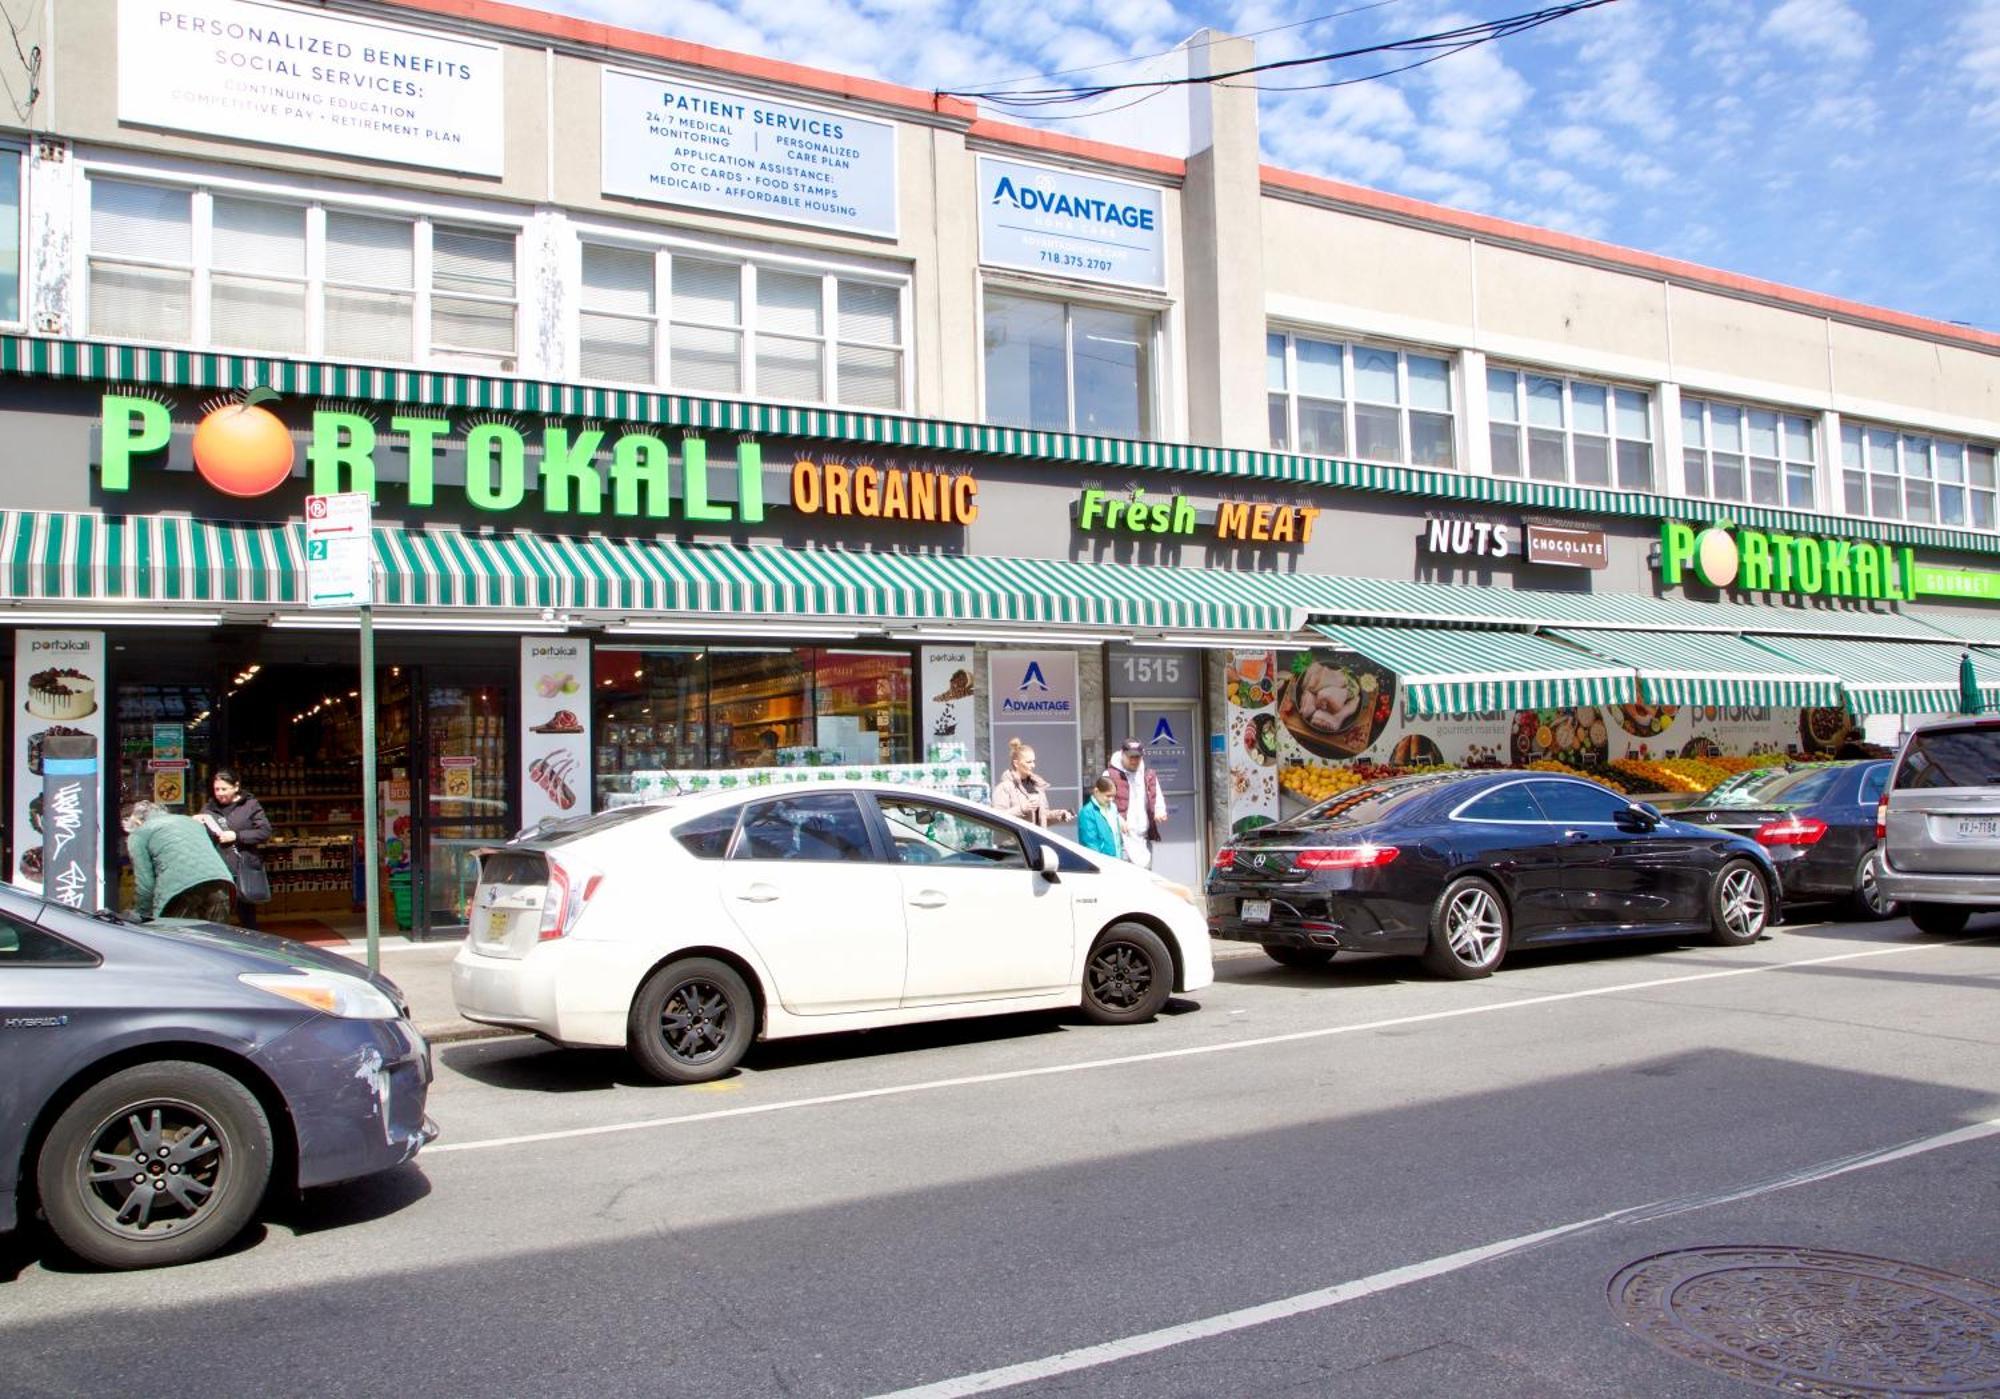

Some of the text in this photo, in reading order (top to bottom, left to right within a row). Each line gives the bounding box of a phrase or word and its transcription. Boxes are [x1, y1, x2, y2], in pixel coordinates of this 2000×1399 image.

[159, 11, 472, 80] PERSONALIZED BENEFITS
[215, 50, 423, 98] SOCIAL SERVICES:
[225, 79, 415, 119] CONTINUING EDUCATION
[664, 93, 844, 139] PATIENT SERVICES
[285, 107, 313, 120] PAY
[332, 115, 419, 137] RETIREMENT
[426, 129, 461, 143] PLAN
[649, 125, 730, 148] MONITORING
[679, 117, 733, 135] MEDICAL
[674, 147, 755, 168] APPLICATION
[776, 135, 860, 159] PERSONALIZED
[787, 150, 850, 169] CARE PLAN
[649, 174, 857, 216] MEDICAID AFFORDABLE HOUSING
[670, 162, 838, 198] OTC CARDS FOOD STAMPS
[992, 177, 1154, 230] ADVANTAGE
[1040, 251, 1112, 271] 718.375.2707
[792, 460, 978, 526] ORGANIC
[1081, 489, 1320, 543] Fresh MEAT
[312, 541, 324, 560] 2
[1429, 519, 1509, 557] NUTS
[1532, 538, 1602, 556] CHOCOLATE
[1123, 658, 1179, 682] 1515
[1002, 697, 1070, 712] ADVANTAGE
